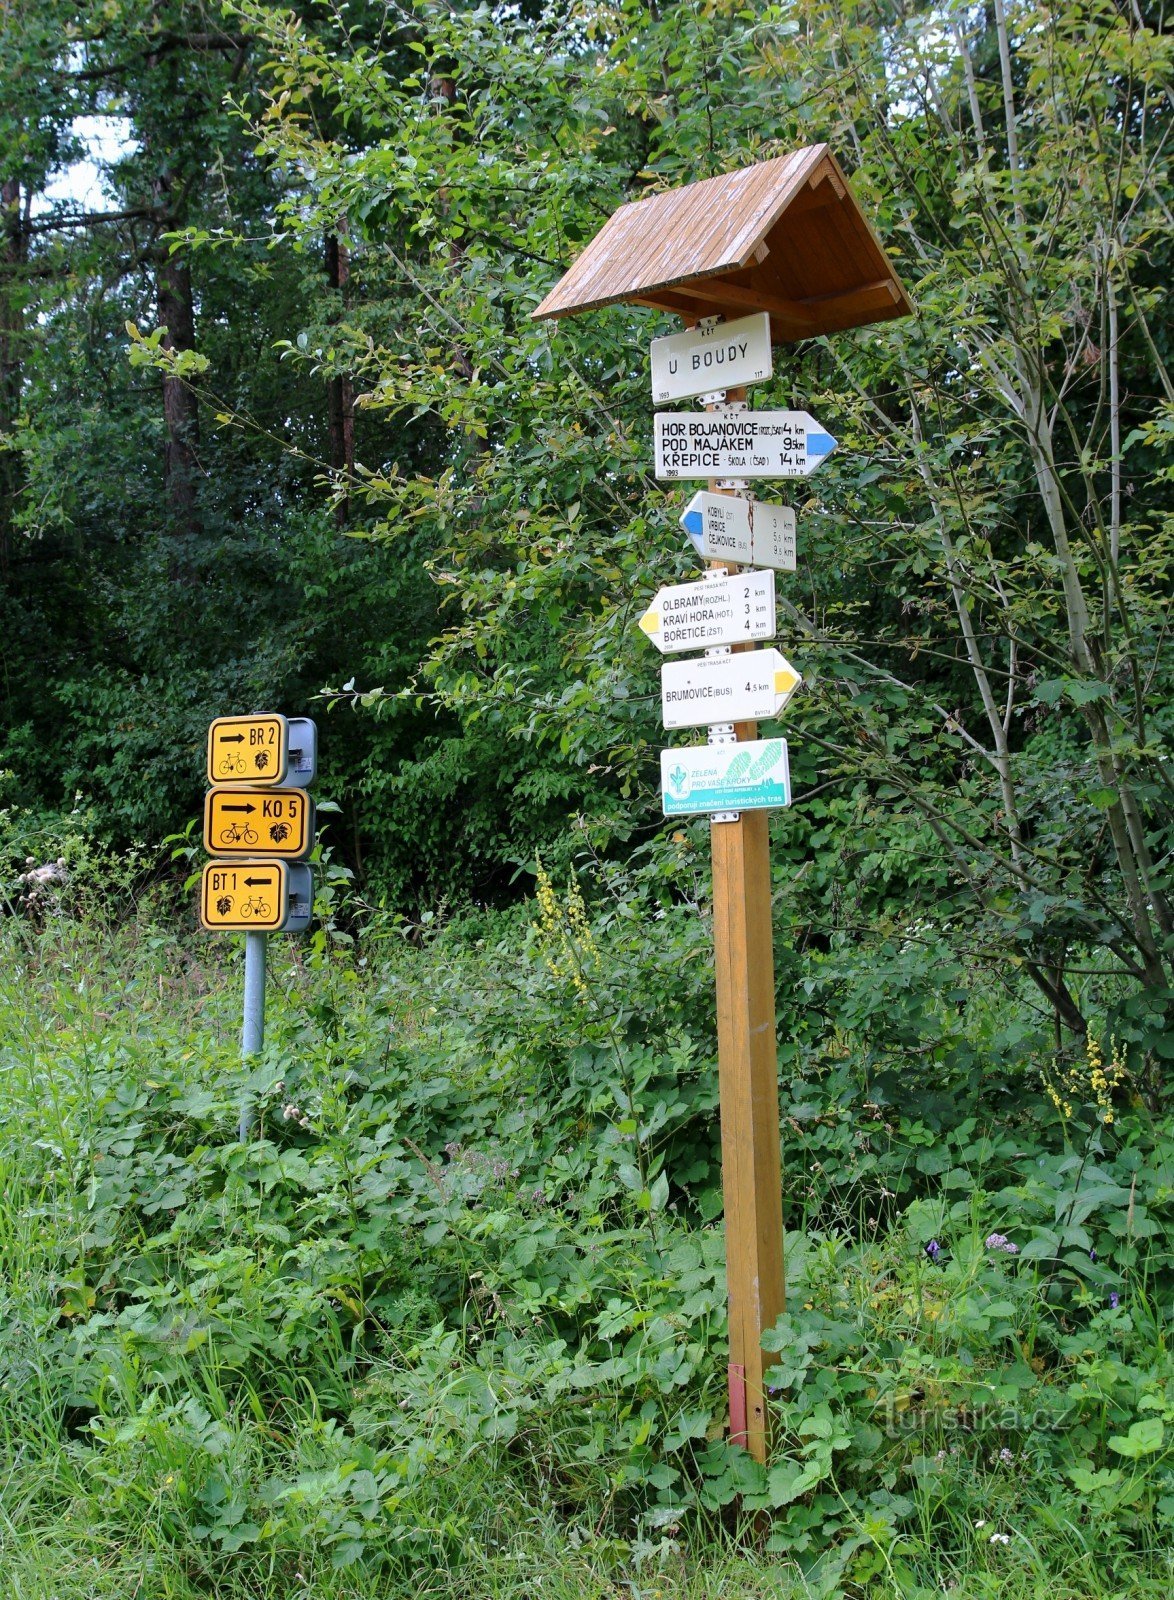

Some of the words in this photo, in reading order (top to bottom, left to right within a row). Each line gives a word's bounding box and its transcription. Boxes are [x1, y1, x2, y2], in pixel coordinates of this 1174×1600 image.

[669, 359, 678, 374] U
[692, 342, 748, 370] BOUDY
[658, 391, 670, 400] 1993
[689, 423, 758, 436] BOJANOVICE
[783, 423, 792, 435] 4
[795, 424, 805, 435] km
[662, 438, 688, 451] POD
[694, 435, 753, 451] MAJÁKEM
[662, 451, 720, 466] KŘEPICE
[728, 455, 746, 466] ŠKOLA
[779, 453, 792, 466] 14
[796, 454, 806, 466] km
[772, 518, 777, 528] 3
[783, 520, 793, 531] km
[783, 533, 794, 545] km
[783, 547, 794, 558] km
[743, 587, 750, 599] 2
[754, 588, 766, 597] km
[663, 594, 704, 611] OLBRAMY
[744, 604, 751, 614] 3
[755, 605, 766, 613] km
[663, 611, 688, 627] KRAVÍ
[690, 609, 714, 622] HORA
[744, 619, 750, 630] 4
[755, 620, 766, 629] km
[663, 626, 706, 642] BOŘETICE
[666, 686, 713, 702] BRUMOVICE
[714, 687, 733, 698] (BUS)
[758, 683, 769, 692] km
[249, 728, 264, 746] BR
[268, 727, 275, 744] 2
[691, 780, 706, 788] PRO
[726, 777, 751, 785] KROKY
[263, 800, 282, 818] KO
[288, 800, 297, 818] 5
[213, 873, 228, 891] BT
[232, 873, 237, 890] 1
